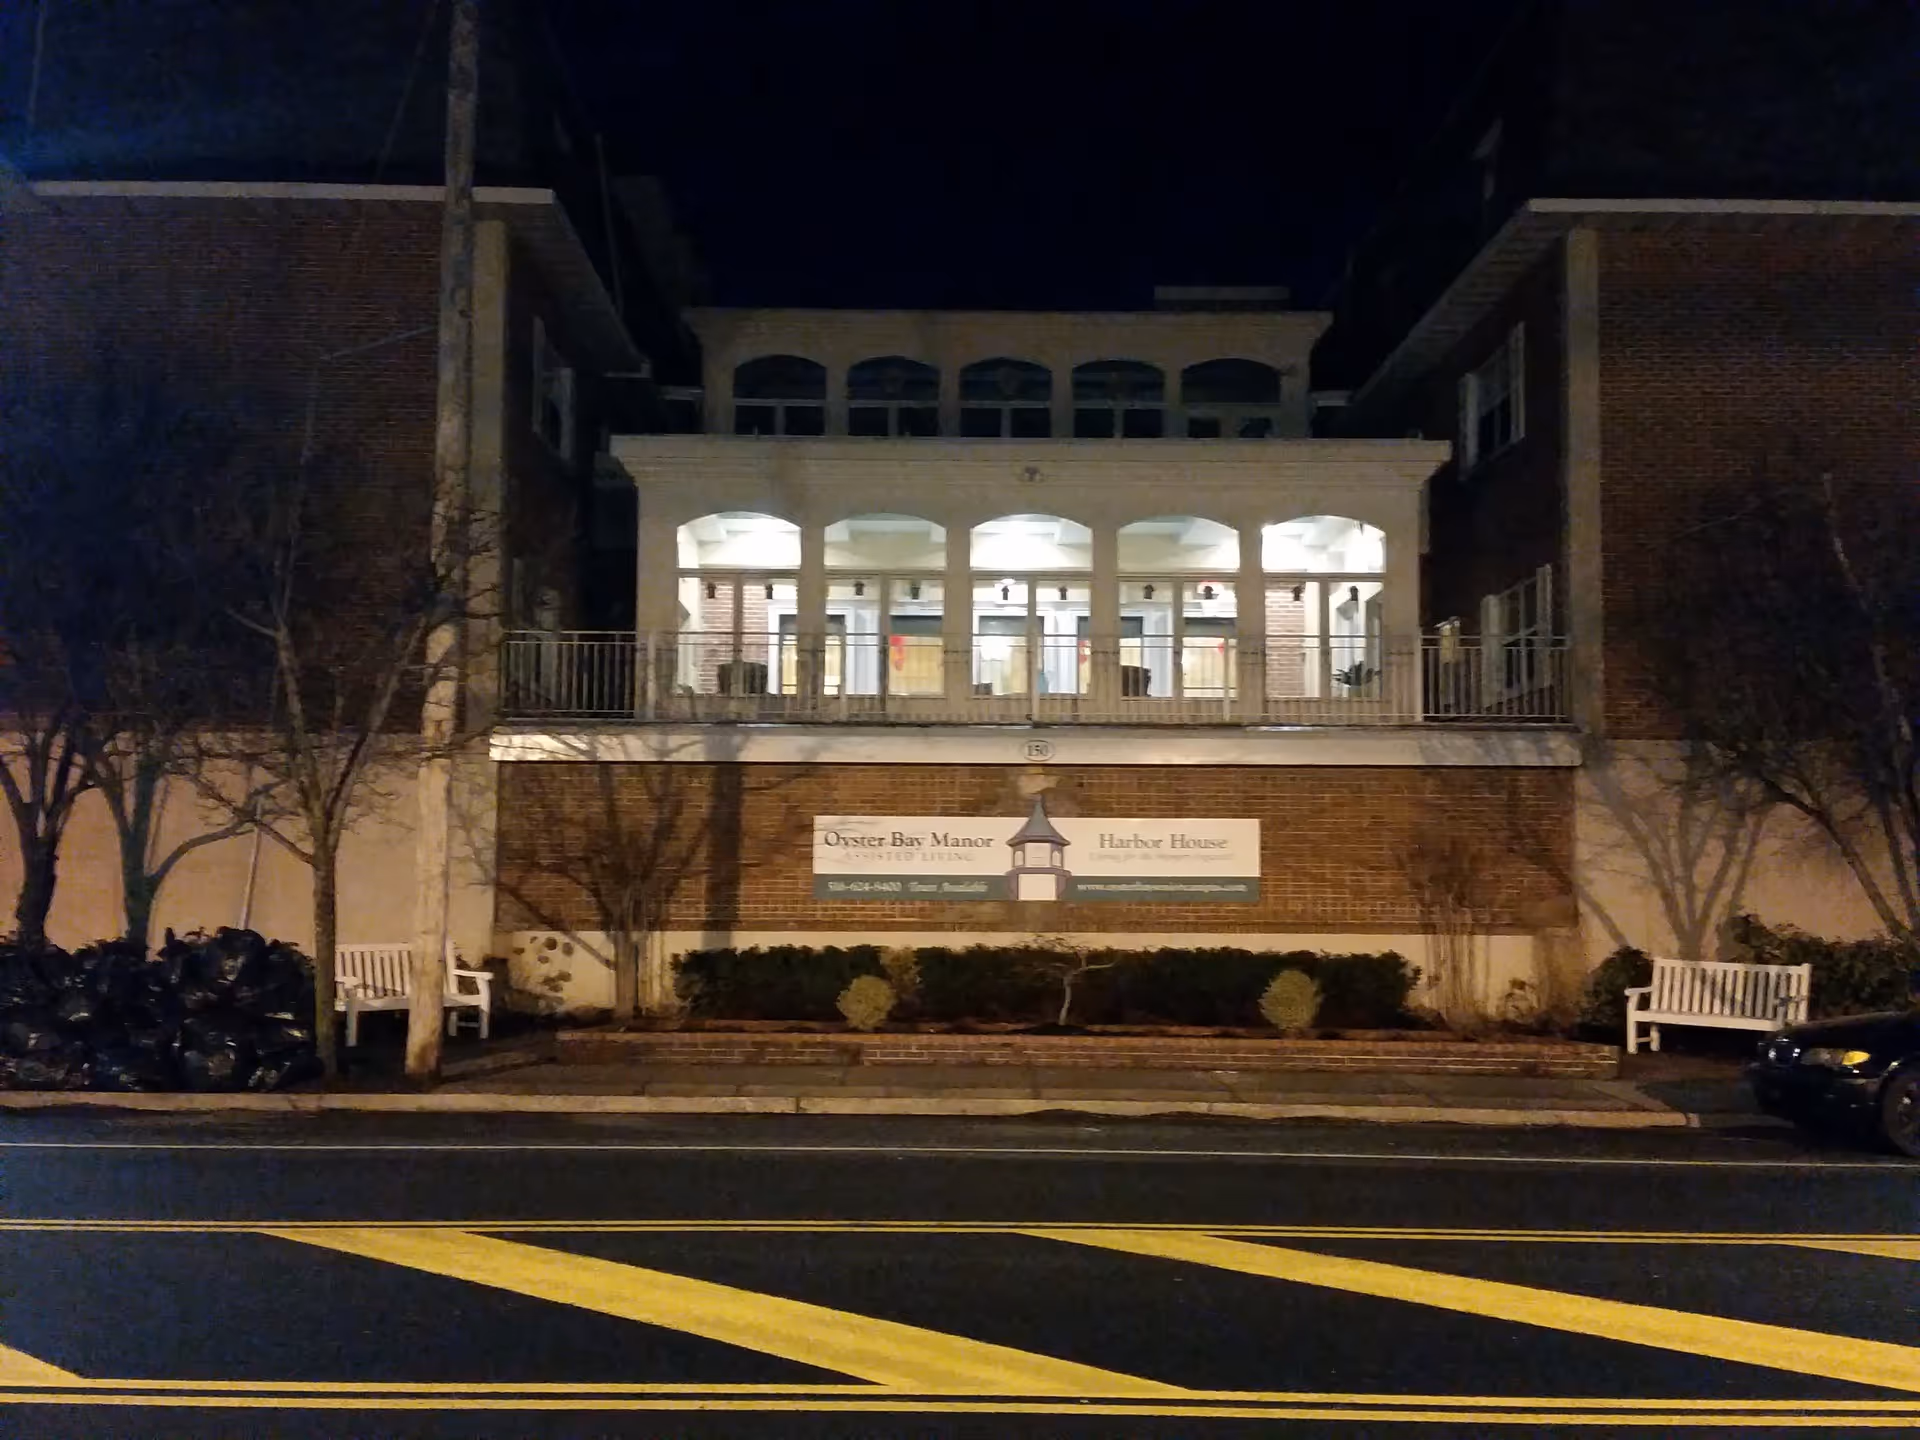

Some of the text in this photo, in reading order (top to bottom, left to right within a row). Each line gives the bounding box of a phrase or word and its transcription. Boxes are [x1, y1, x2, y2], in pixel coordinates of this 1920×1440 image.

[824, 831, 995, 850] Oyster Bay Manor
[1099, 833, 1229, 850] Harbor House
[921, 851, 975, 862] LIVING
